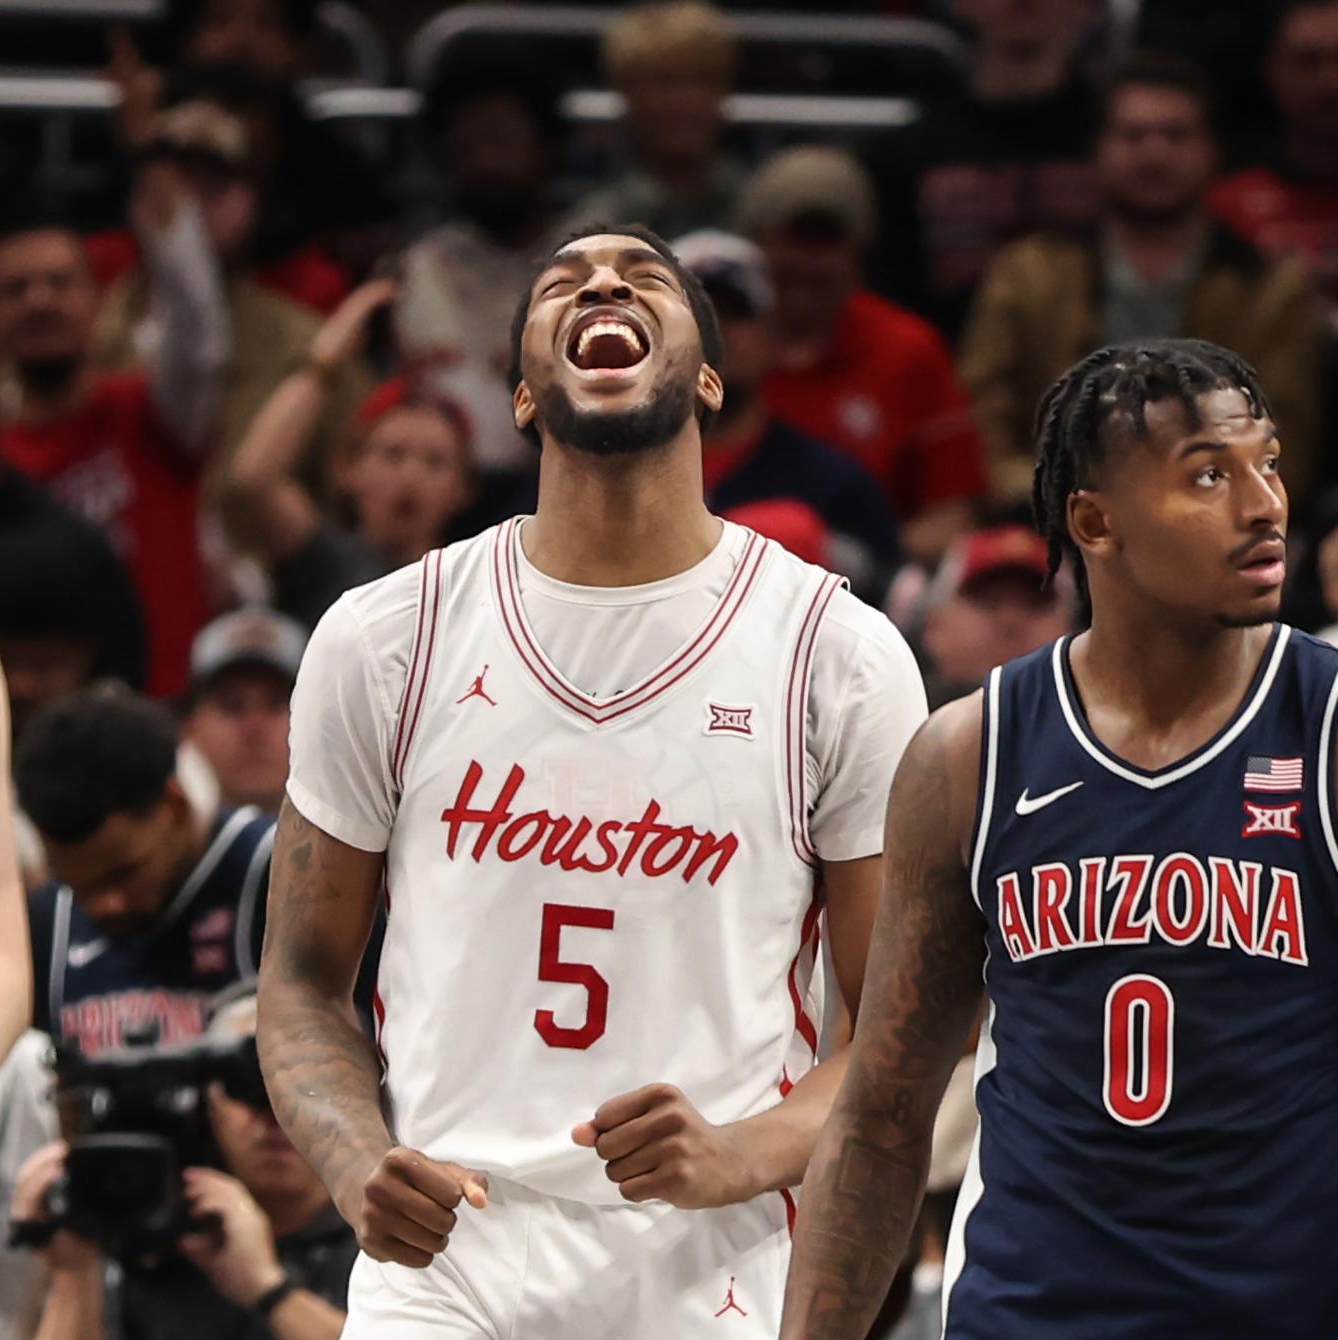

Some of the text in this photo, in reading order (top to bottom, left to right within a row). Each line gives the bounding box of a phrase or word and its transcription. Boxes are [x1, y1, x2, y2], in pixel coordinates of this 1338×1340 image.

[709, 704, 754, 735] XII
[440, 760, 738, 886] Houston
[1244, 802, 1300, 837] XII
[996, 851, 1310, 968] ARIZONA
[533, 902, 615, 1051] 5
[1102, 973, 1174, 1127] 0
